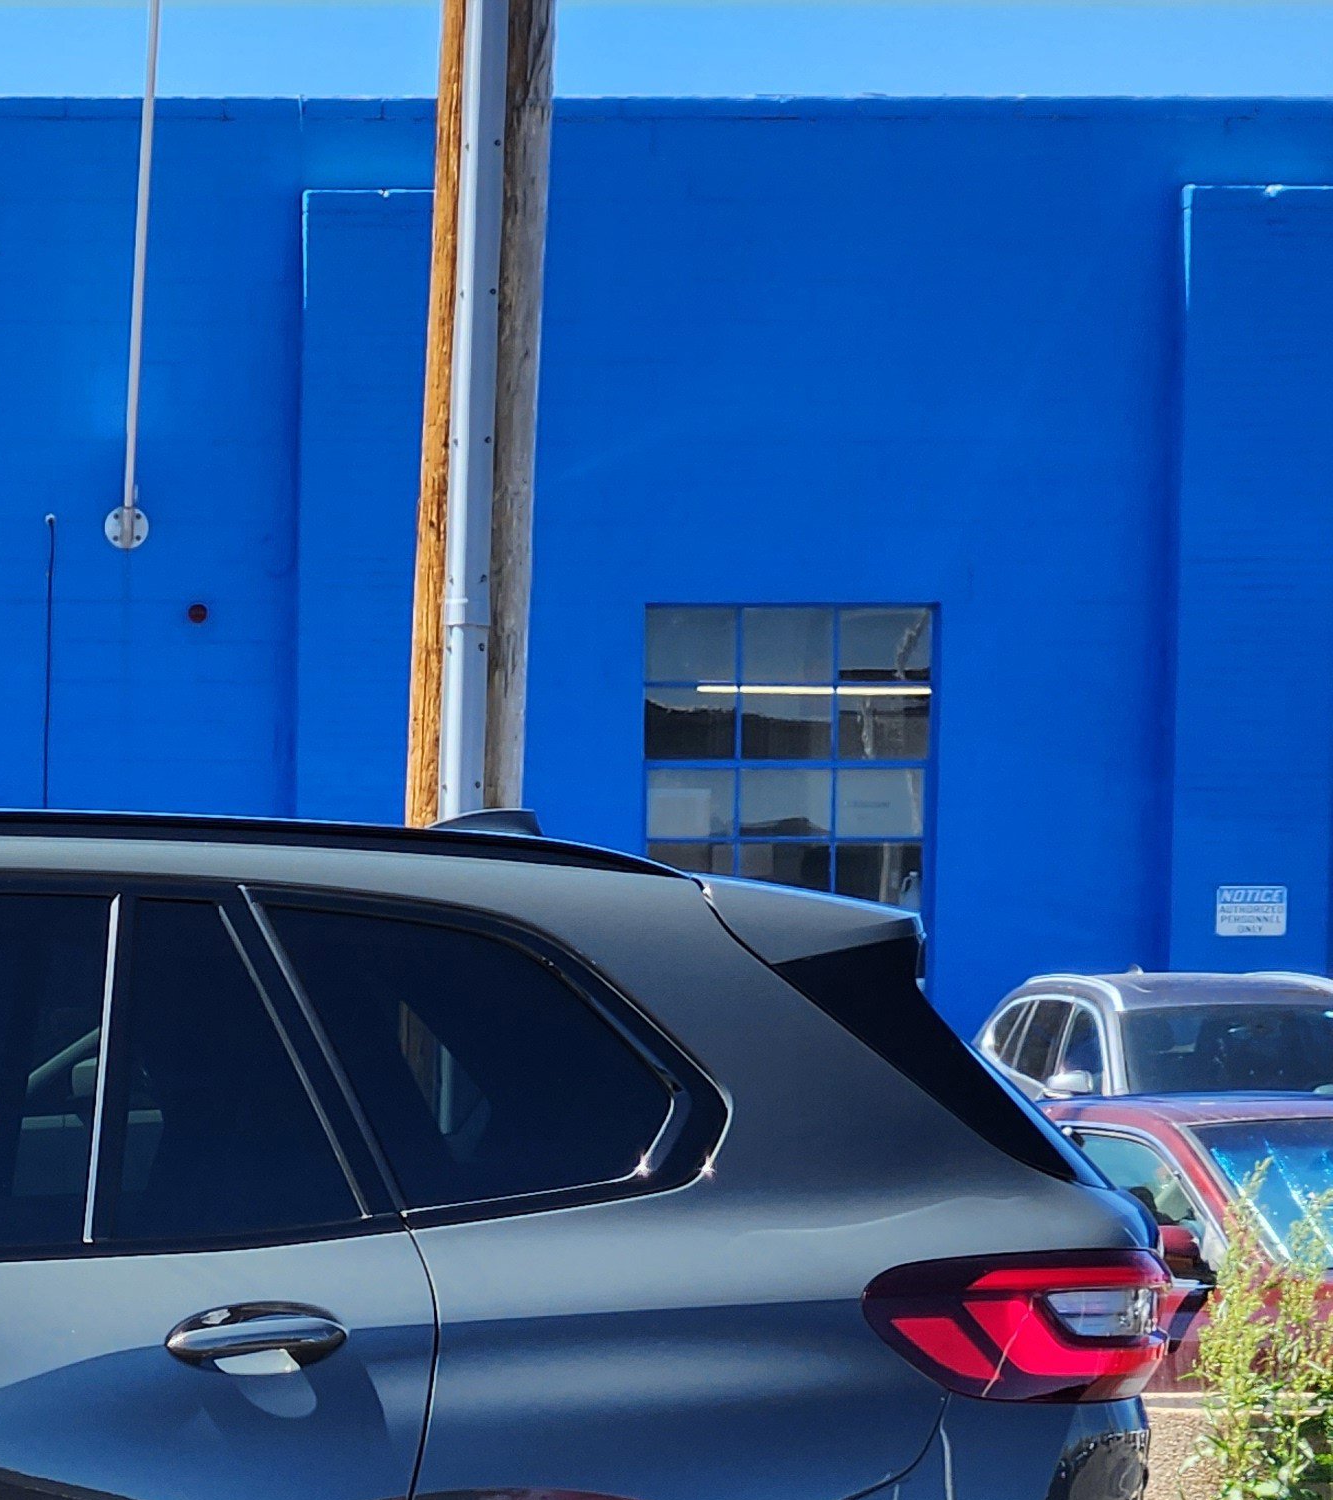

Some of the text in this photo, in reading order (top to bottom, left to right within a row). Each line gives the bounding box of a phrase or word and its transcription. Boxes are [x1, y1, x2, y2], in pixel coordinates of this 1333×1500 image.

[1220, 889, 1283, 902] NOTICE
[1220, 915, 1282, 923] PERSONNEL
[1237, 924, 1263, 933] ONLY
